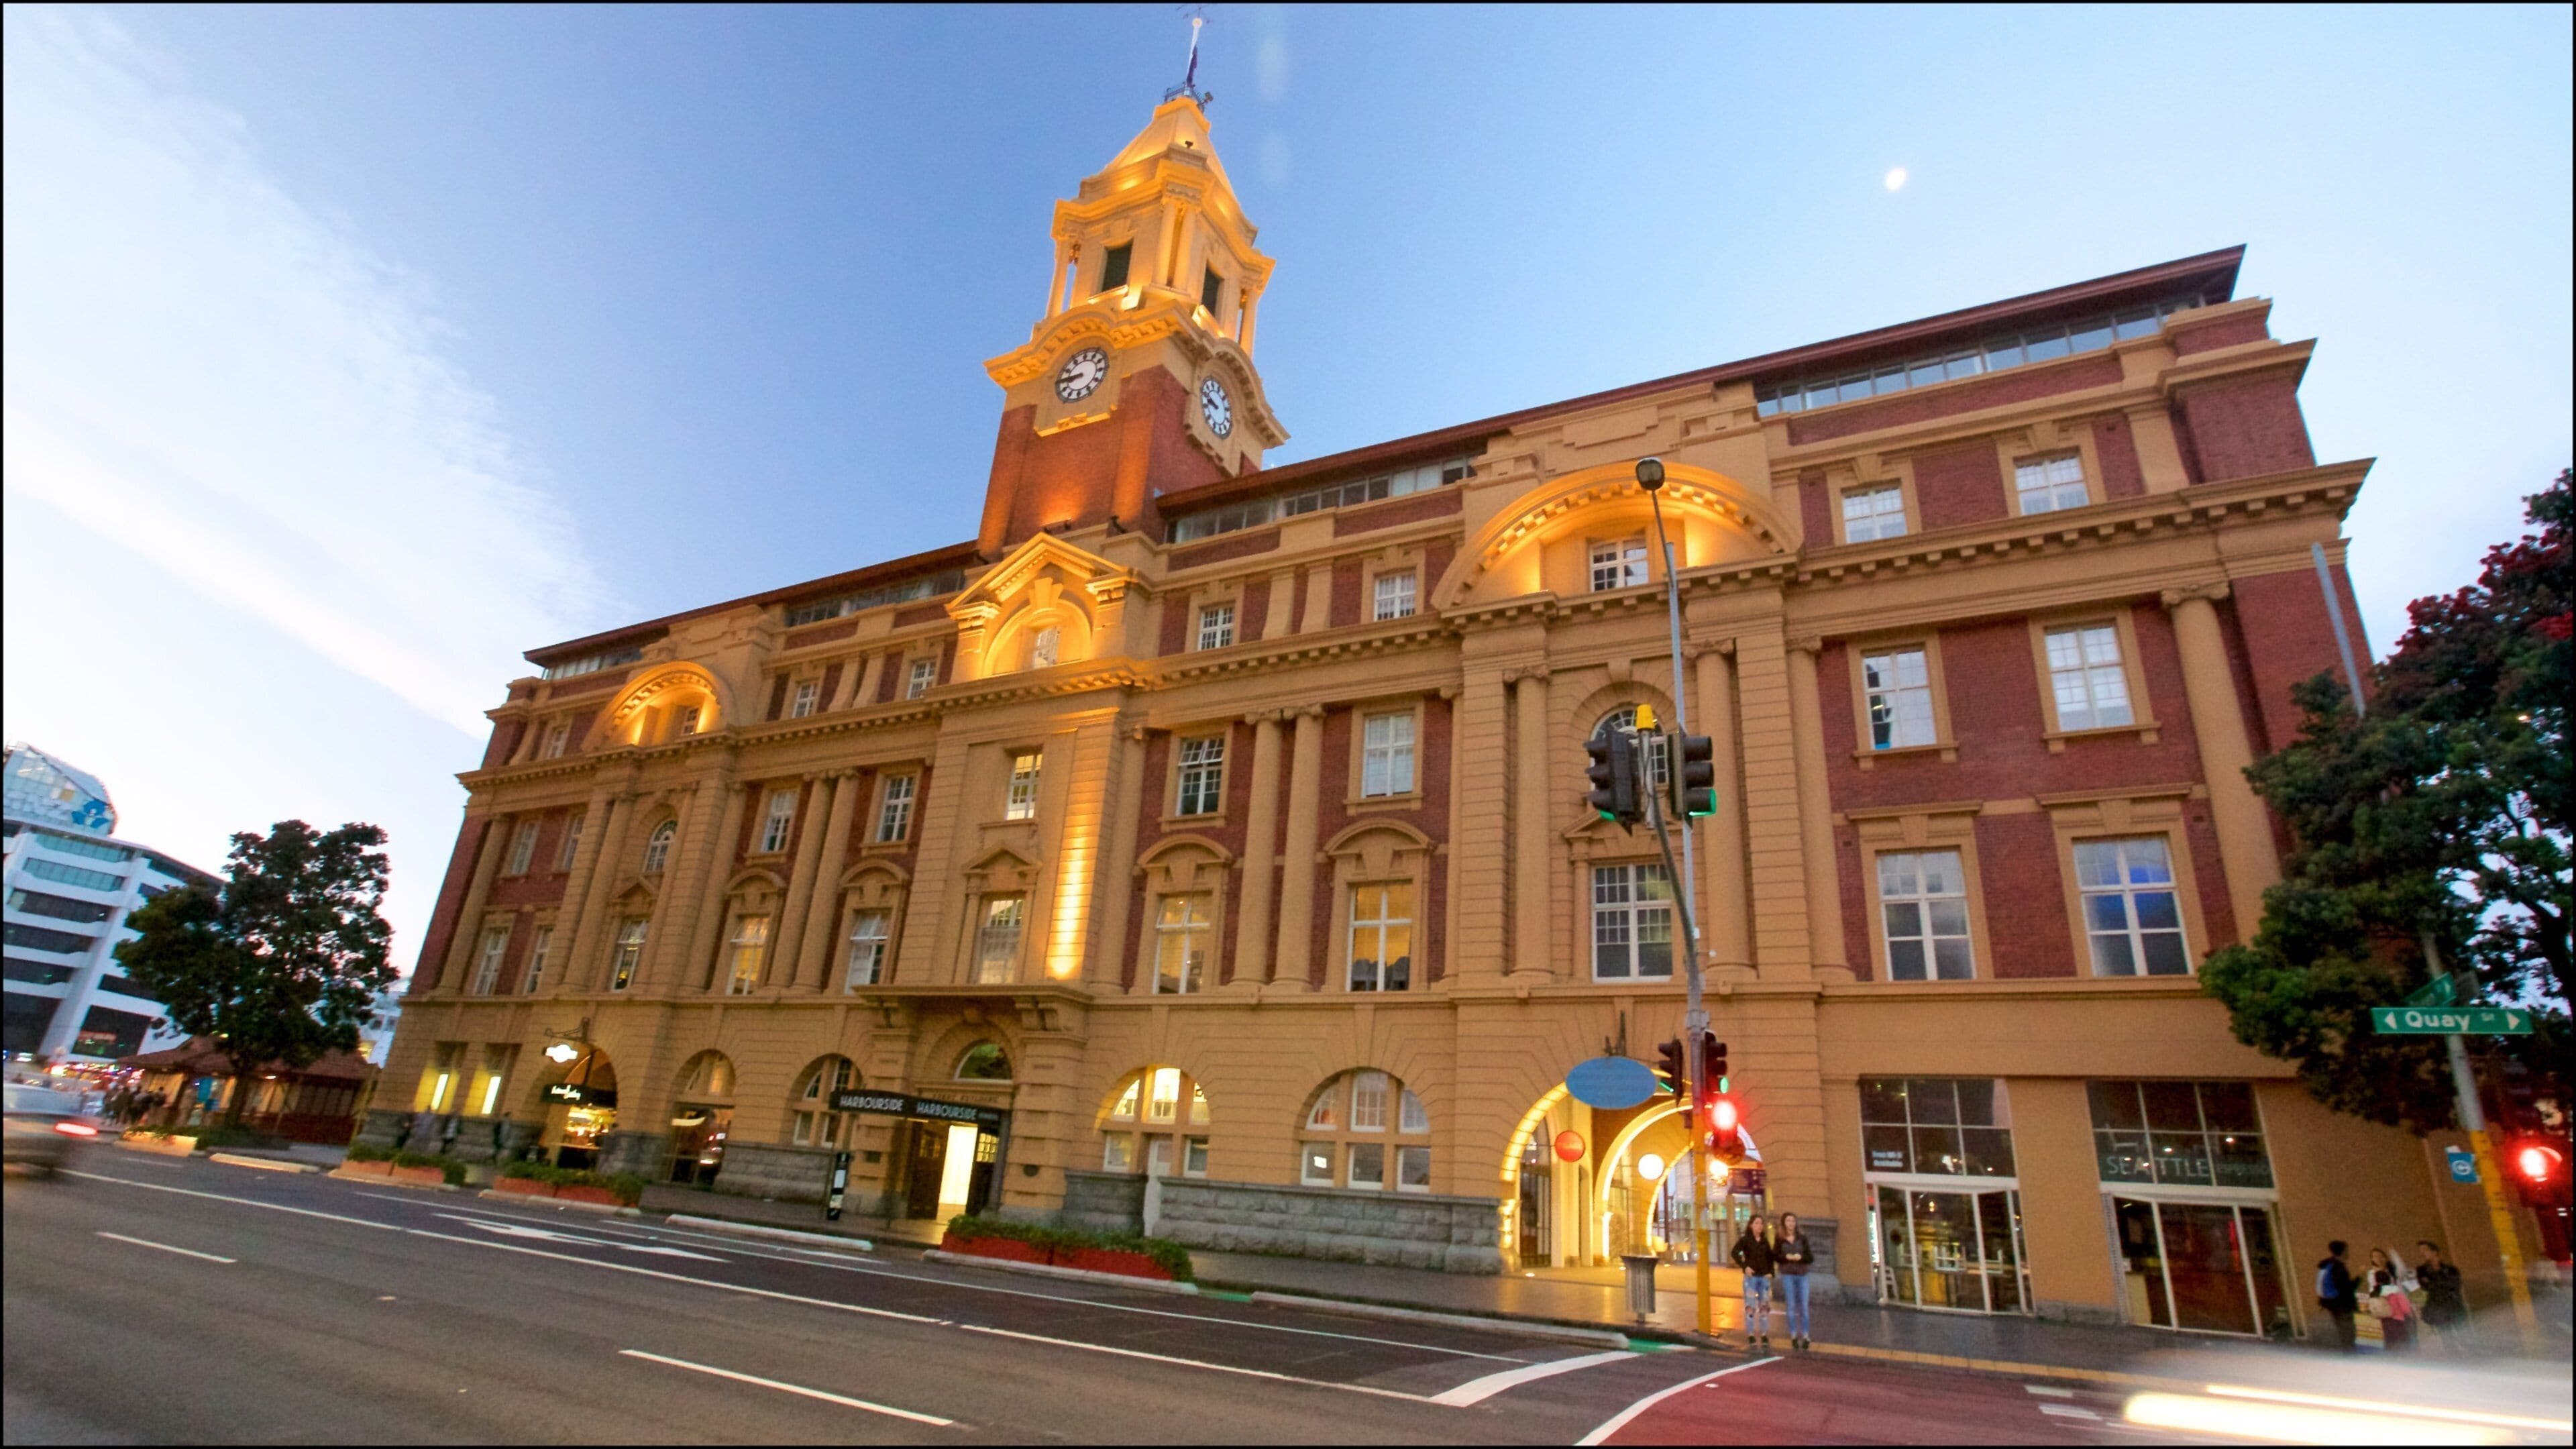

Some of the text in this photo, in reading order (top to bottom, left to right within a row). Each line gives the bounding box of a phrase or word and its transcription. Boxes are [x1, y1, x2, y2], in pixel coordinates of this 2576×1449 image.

[2405, 1010, 2470, 1031] Quay
[840, 1095, 904, 1111] HARBOURSIDE
[916, 1101, 977, 1120] HARBOURSIDE
[2106, 1155, 2209, 1177] SEATTLE
